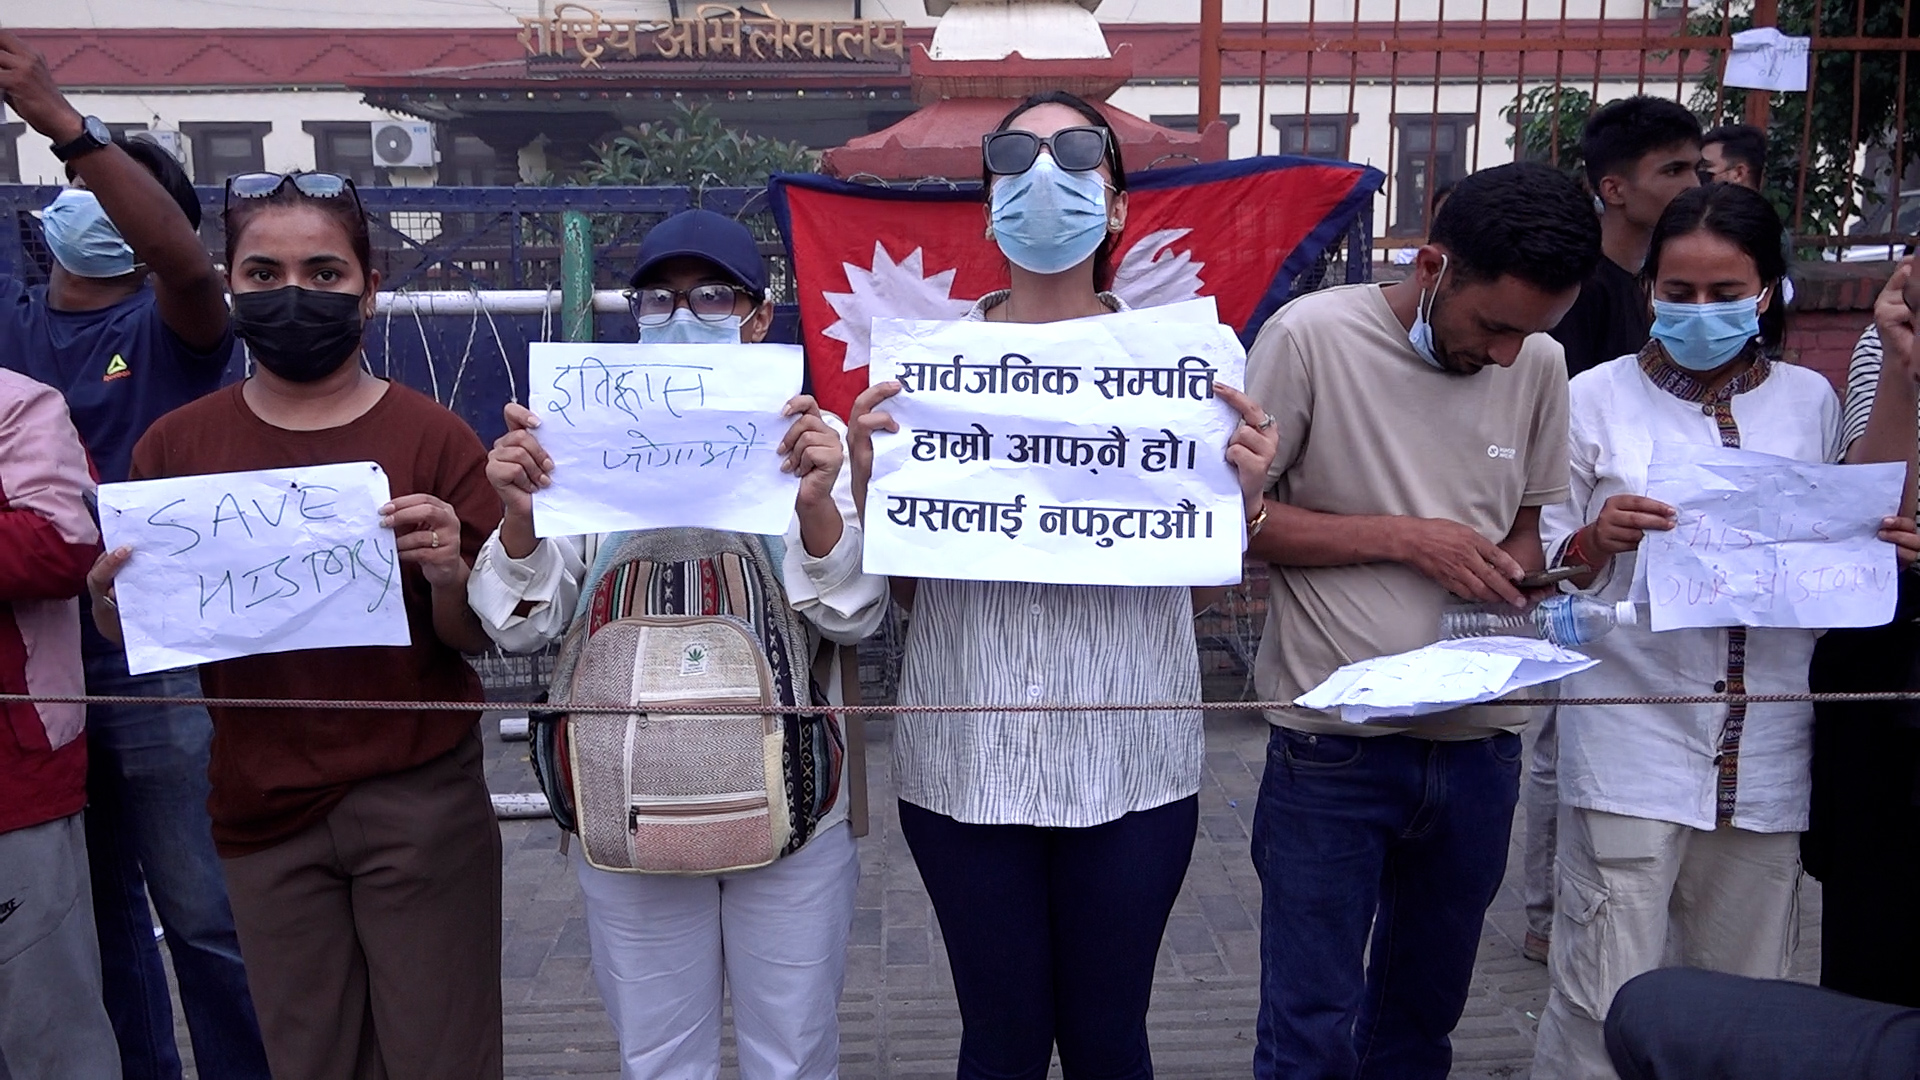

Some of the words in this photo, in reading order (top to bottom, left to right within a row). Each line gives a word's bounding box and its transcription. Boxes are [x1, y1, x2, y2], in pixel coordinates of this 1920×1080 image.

[895, 352, 1082, 396] सार्वजनिक
[1093, 355, 1218, 401] सम्पत्ति
[911, 423, 994, 465] हाम्रो
[147, 484, 340, 557] SAVE
[887, 494, 1027, 540] यसलाई
[199, 538, 395, 620] HISTORY
